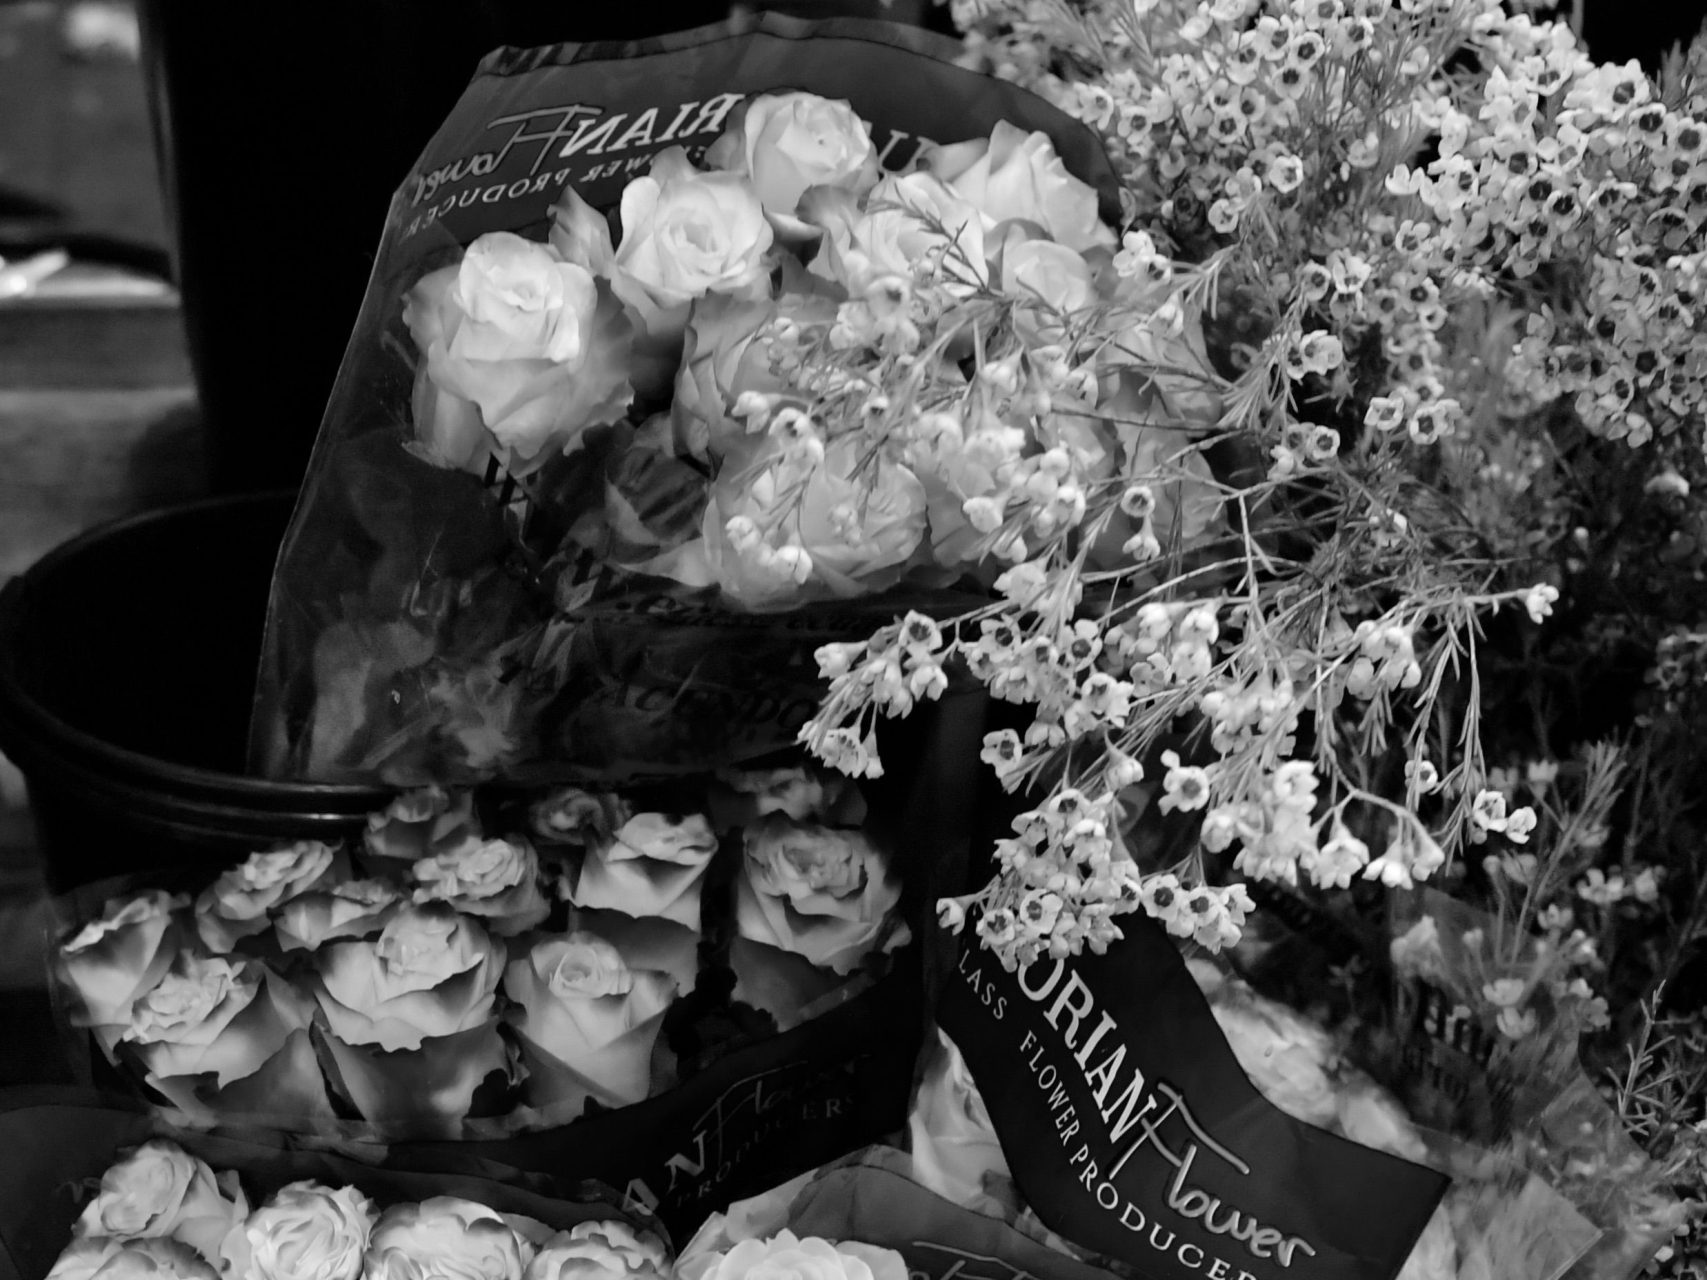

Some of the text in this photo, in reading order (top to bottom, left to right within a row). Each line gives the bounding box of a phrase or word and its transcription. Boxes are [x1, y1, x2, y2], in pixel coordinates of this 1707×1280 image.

[958, 948, 1008, 1020] LASS
[1019, 1029, 1083, 1147] FLOWER
[1017, 957, 1158, 1145] ORIAN
